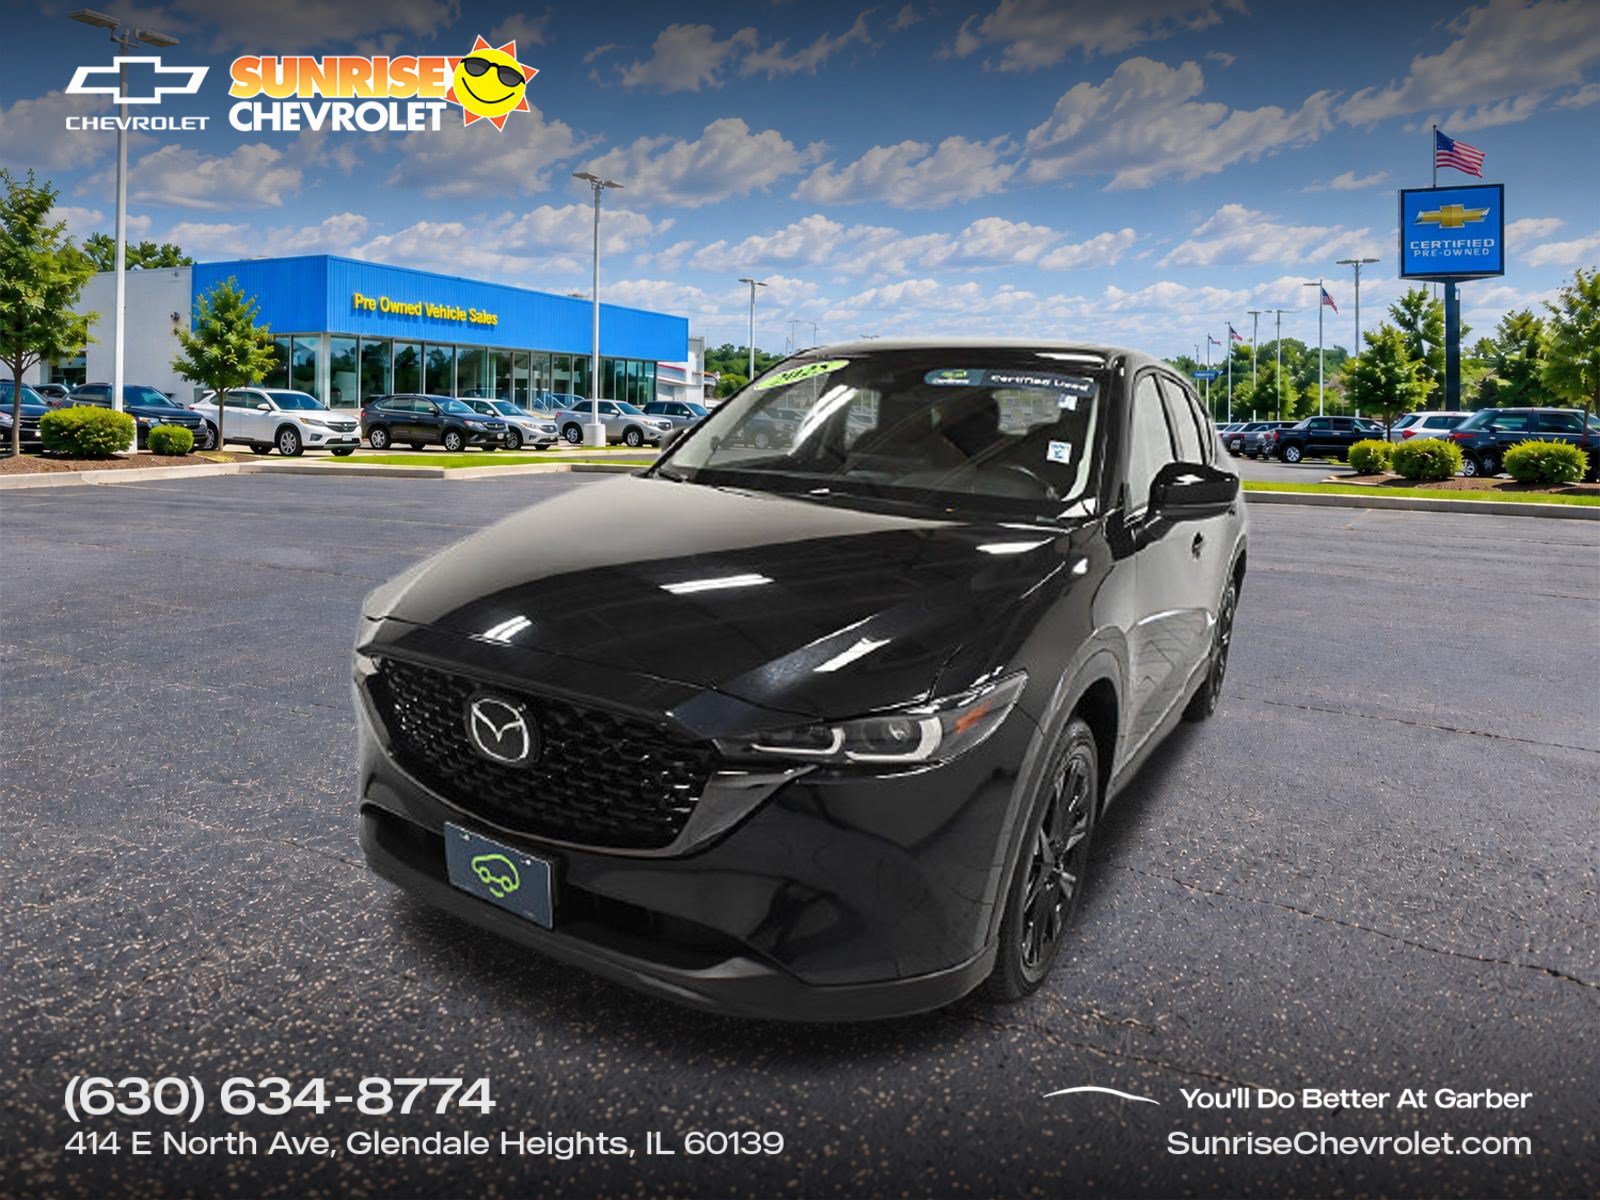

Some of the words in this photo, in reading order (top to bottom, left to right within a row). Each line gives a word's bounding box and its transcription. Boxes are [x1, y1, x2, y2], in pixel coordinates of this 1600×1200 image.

[1410, 238, 1495, 250] CERTIFIED
[1413, 248, 1490, 257] PRE-OWNED
[353, 293, 376, 310] Pre
[379, 296, 422, 316] Owned
[424, 302, 466, 321] Vehicle
[468, 308, 498, 325] Sales
